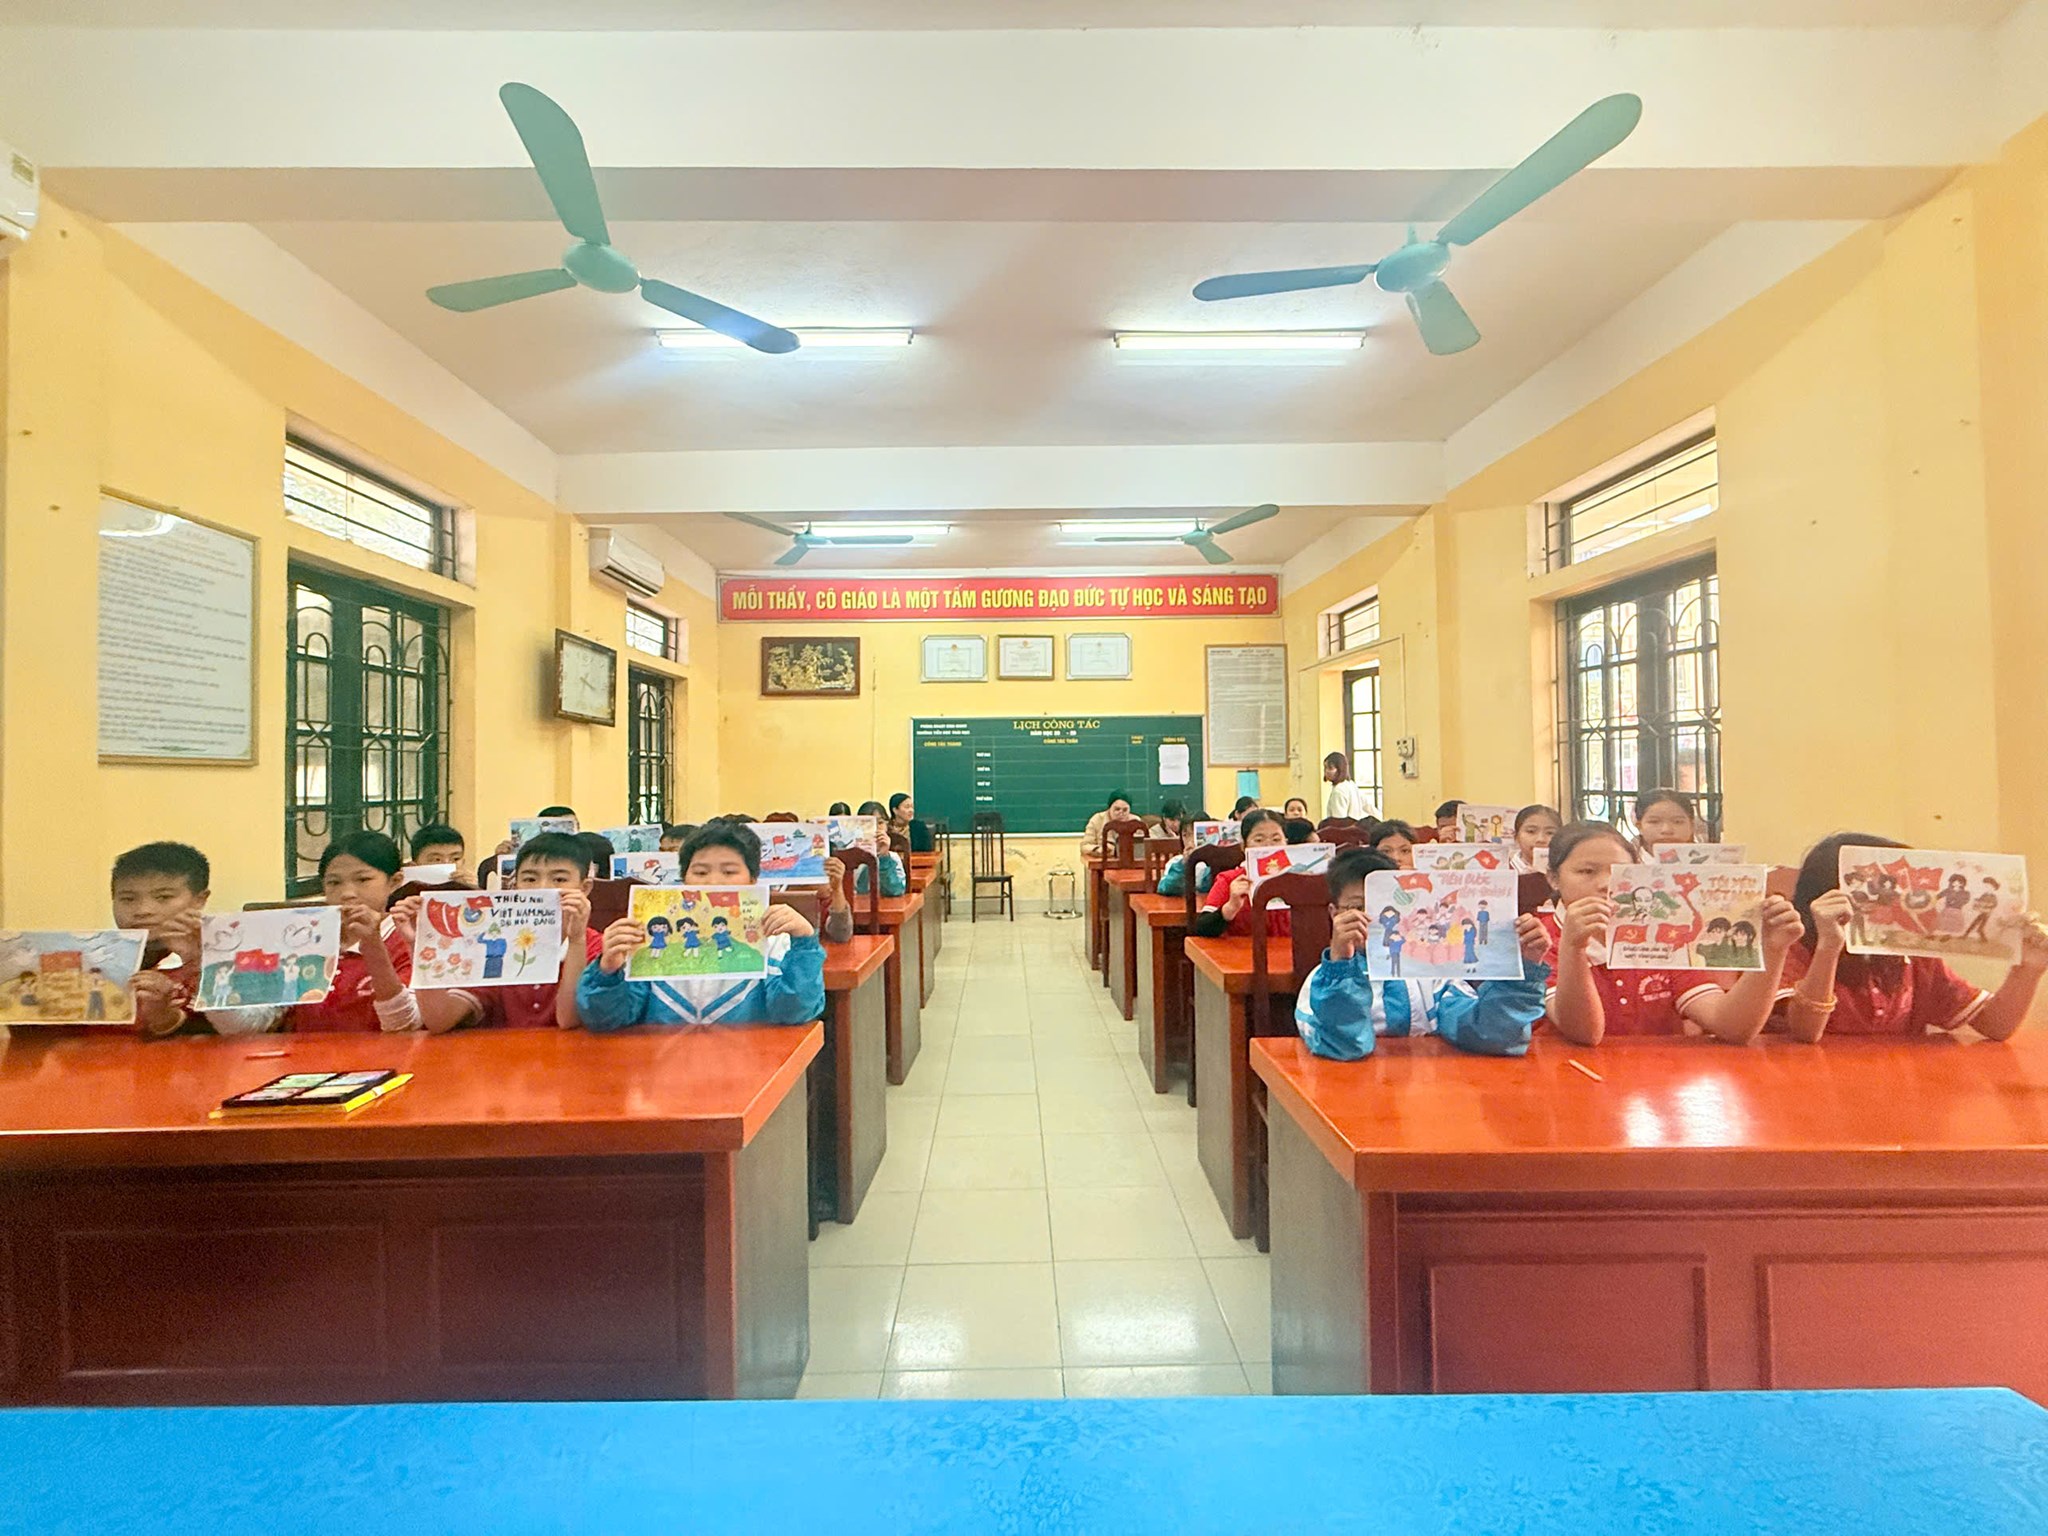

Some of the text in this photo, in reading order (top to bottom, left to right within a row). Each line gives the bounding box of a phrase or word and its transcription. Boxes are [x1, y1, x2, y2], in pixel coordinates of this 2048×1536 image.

[733, 584, 763, 610] MỖI
[816, 587, 837, 609] CÔ
[841, 586, 878, 609] GIÁO
[882, 587, 902, 609] LÀ
[905, 587, 939, 613] MỘT
[943, 583, 977, 609] TẤM
[981, 588, 1034, 609] GƯƠNG
[1038, 588, 1069, 612] ĐẠO
[1073, 583, 1105, 607] ĐỨC
[1109, 586, 1130, 611] TỰ
[1132, 587, 1163, 611] HỌC
[1168, 583, 1188, 606] VÀ
[1192, 583, 1234, 606] SÁNG
[1238, 586, 1267, 609] TẠO
[1013, 717, 1101, 731] LỊCH CÔNG TÁC
